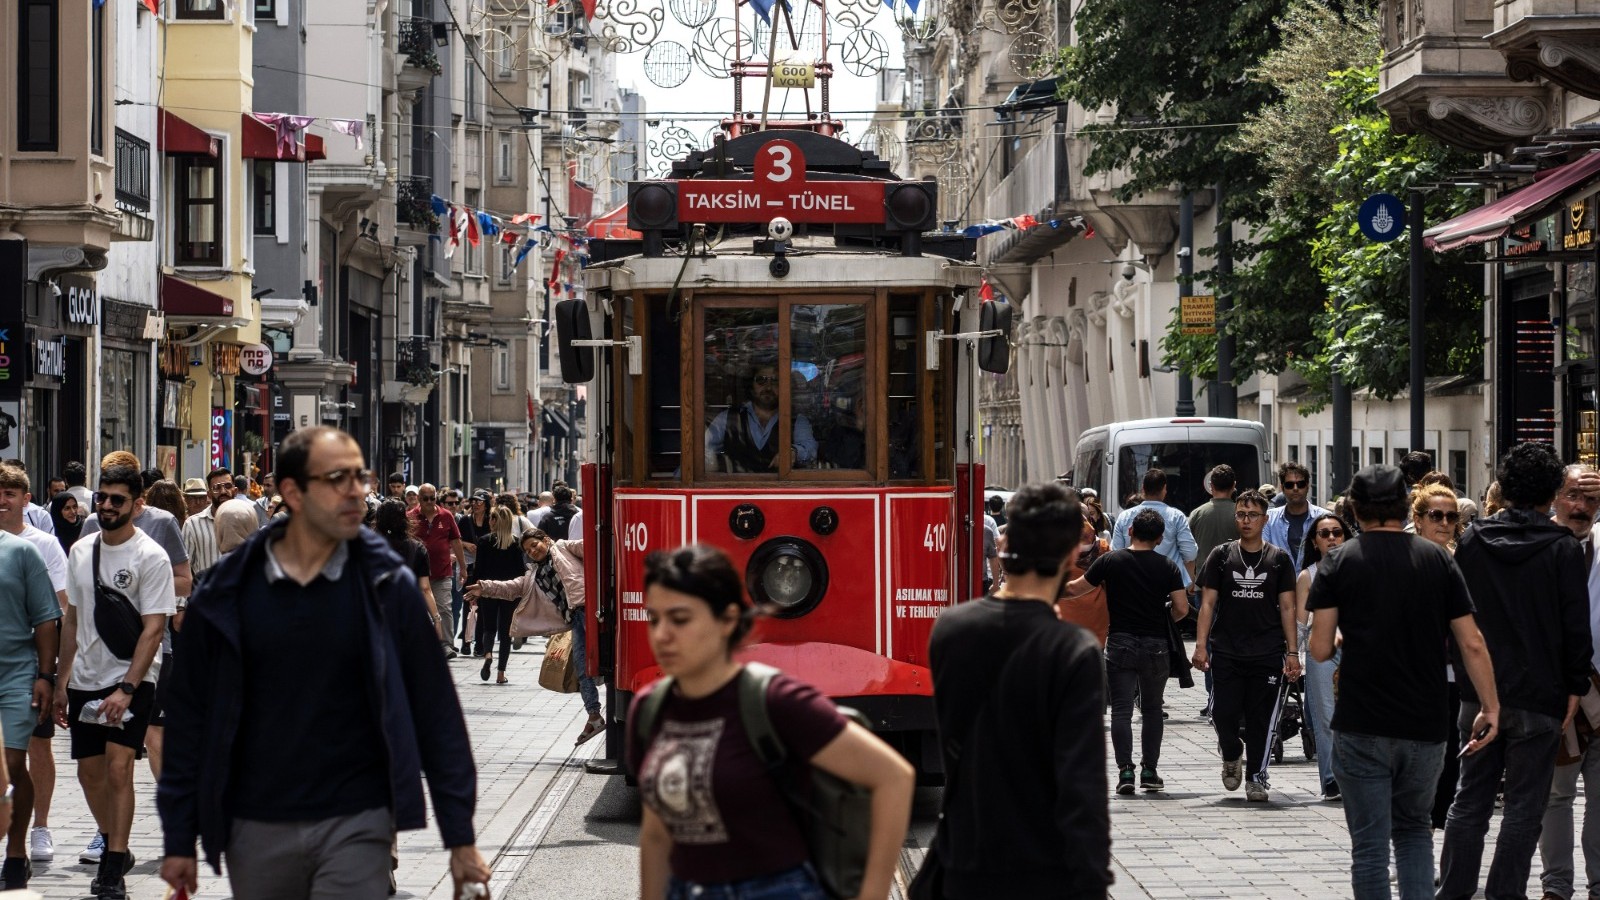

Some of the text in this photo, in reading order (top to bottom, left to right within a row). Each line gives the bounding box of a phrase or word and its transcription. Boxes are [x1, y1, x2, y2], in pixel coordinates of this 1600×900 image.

[782, 67, 807, 76] 600
[780, 78, 808, 86] VOLT
[766, 145, 792, 182] 3
[686, 190, 761, 209] TAKSİM
[789, 191, 855, 211] TÜNEL
[624, 522, 648, 552] 410
[923, 522, 946, 552] 410
[896, 588, 932, 601] ASILMAK
[1232, 589, 1264, 599] adidas
[896, 605, 906, 618] VE
